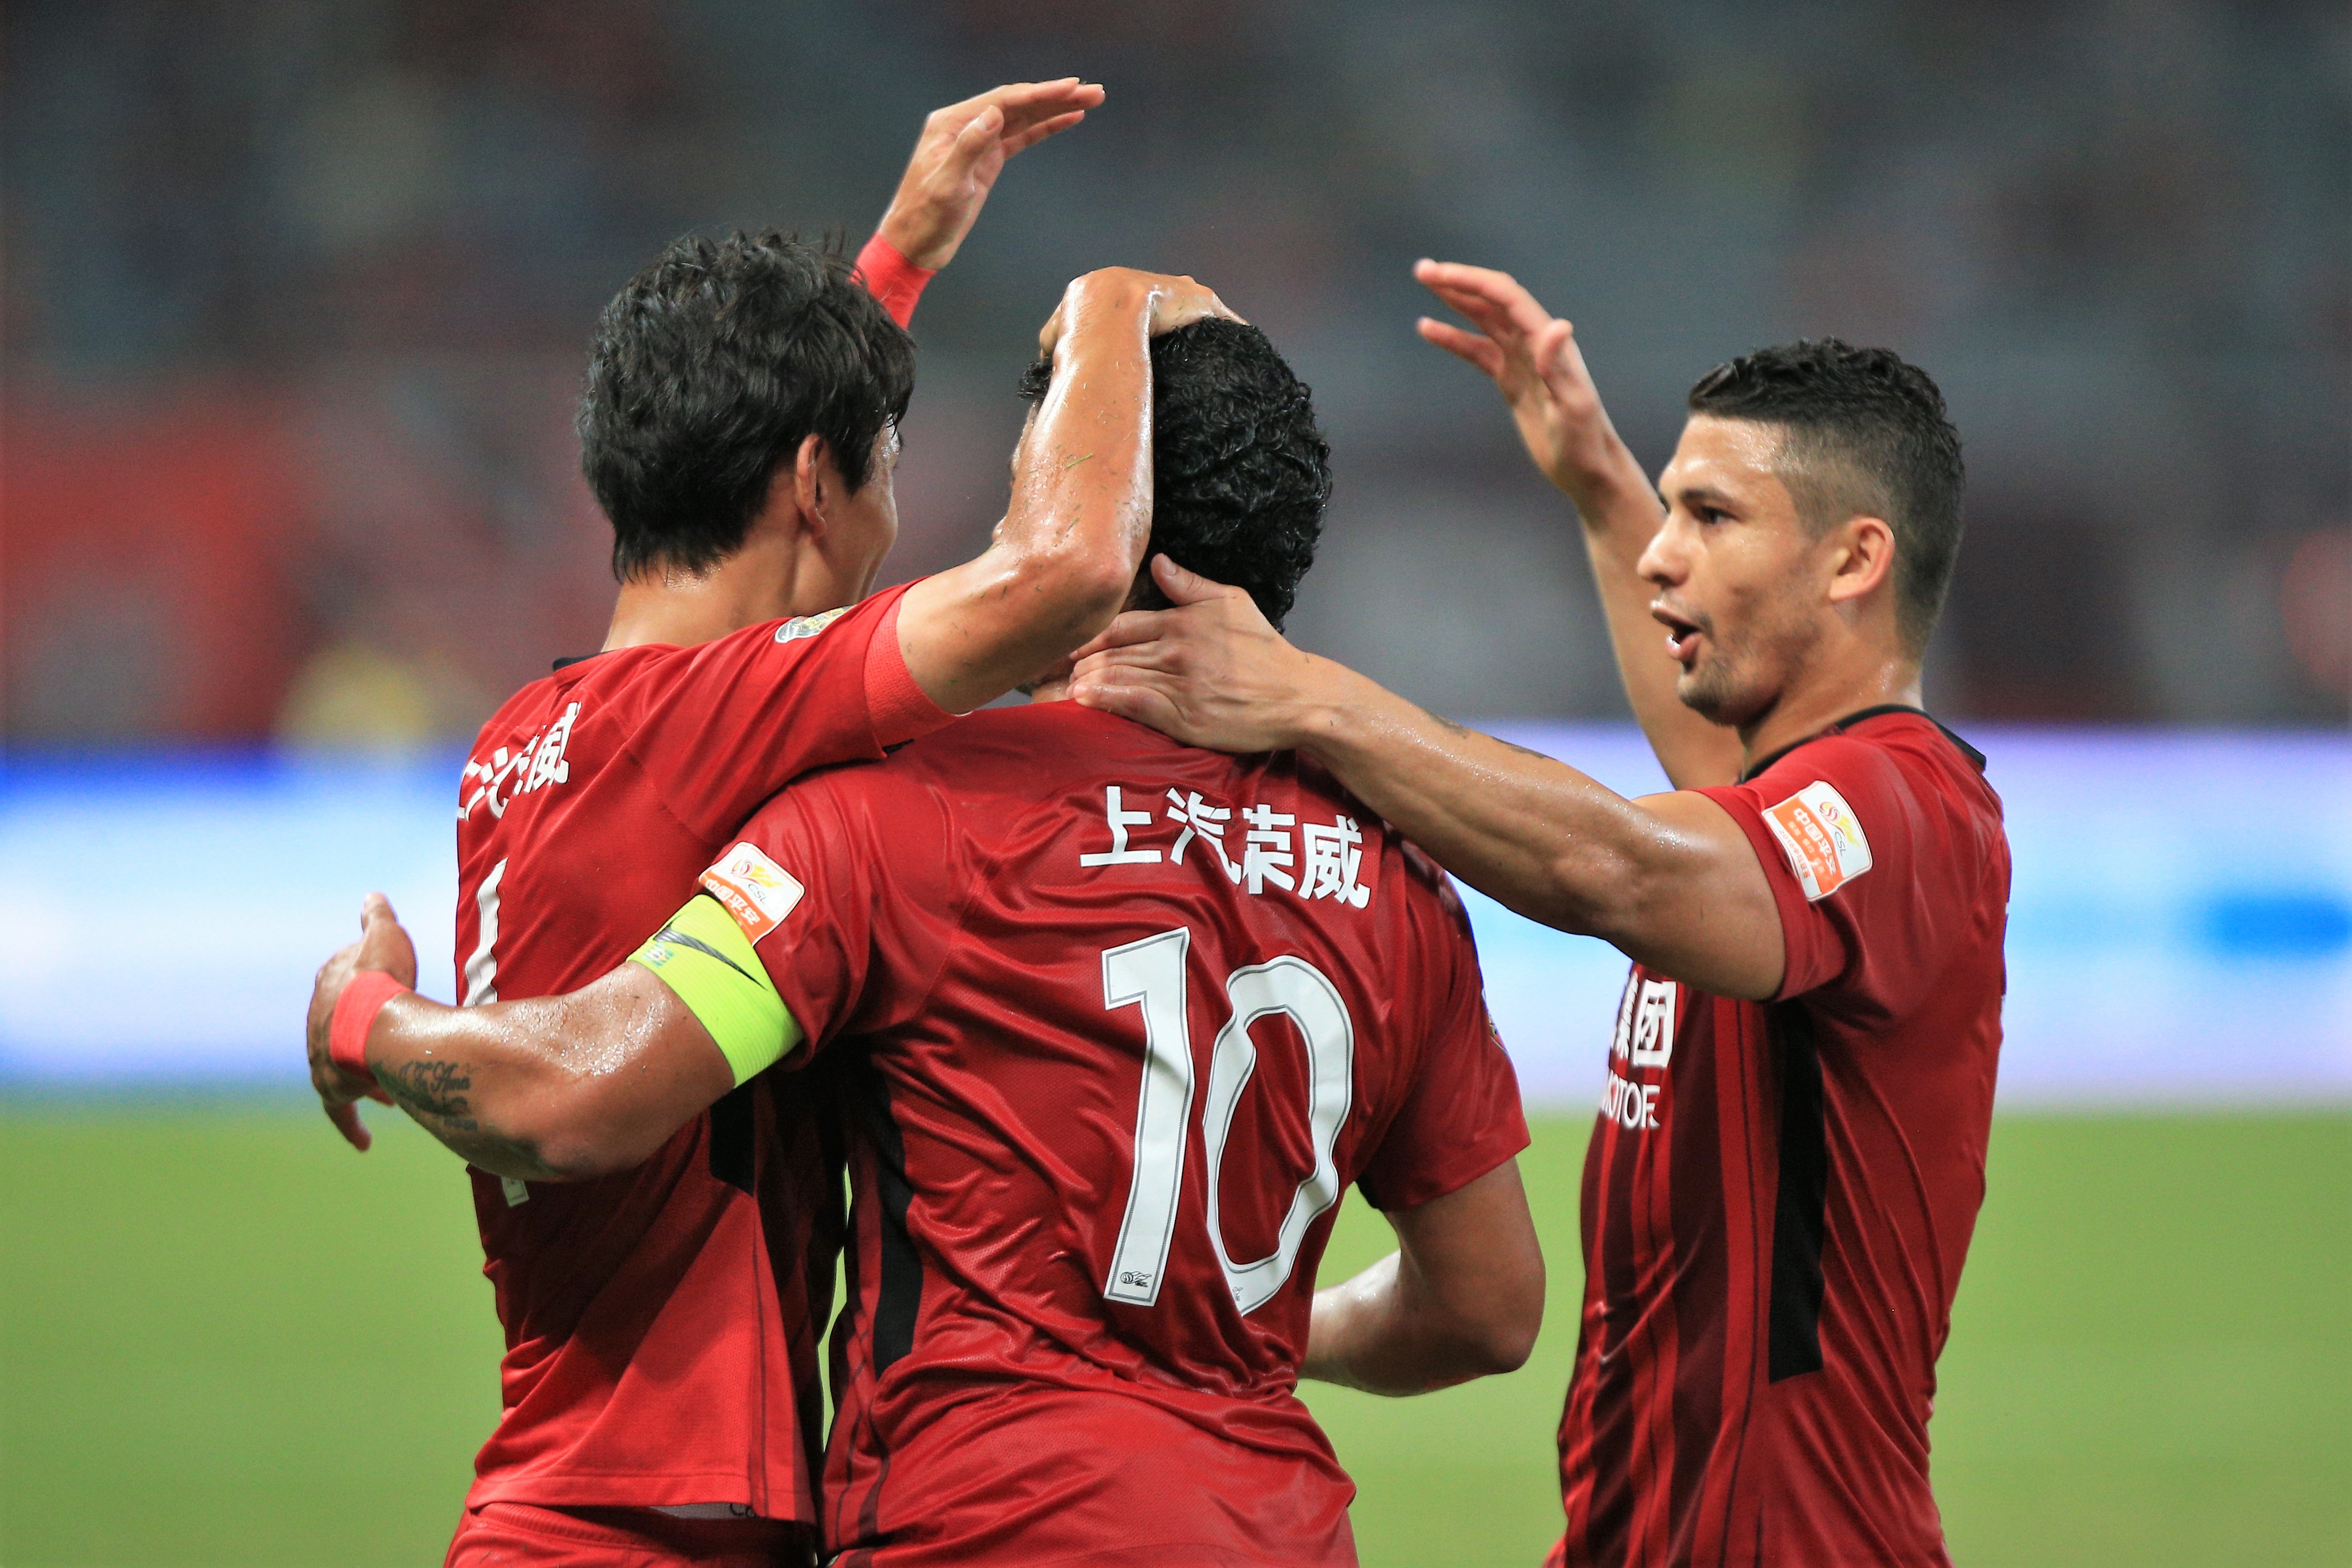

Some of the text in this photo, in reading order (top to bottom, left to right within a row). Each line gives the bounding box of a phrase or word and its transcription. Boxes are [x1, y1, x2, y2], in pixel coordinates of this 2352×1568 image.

[1079, 786, 1371, 909] 上汽荣威
[1793, 807, 1837, 876] 中国平安
[1835, 831, 1847, 857] CSL
[705, 878, 761, 926] 中国平安
[748, 883, 768, 905] CSL
[1102, 926, 1355, 1317] 10
